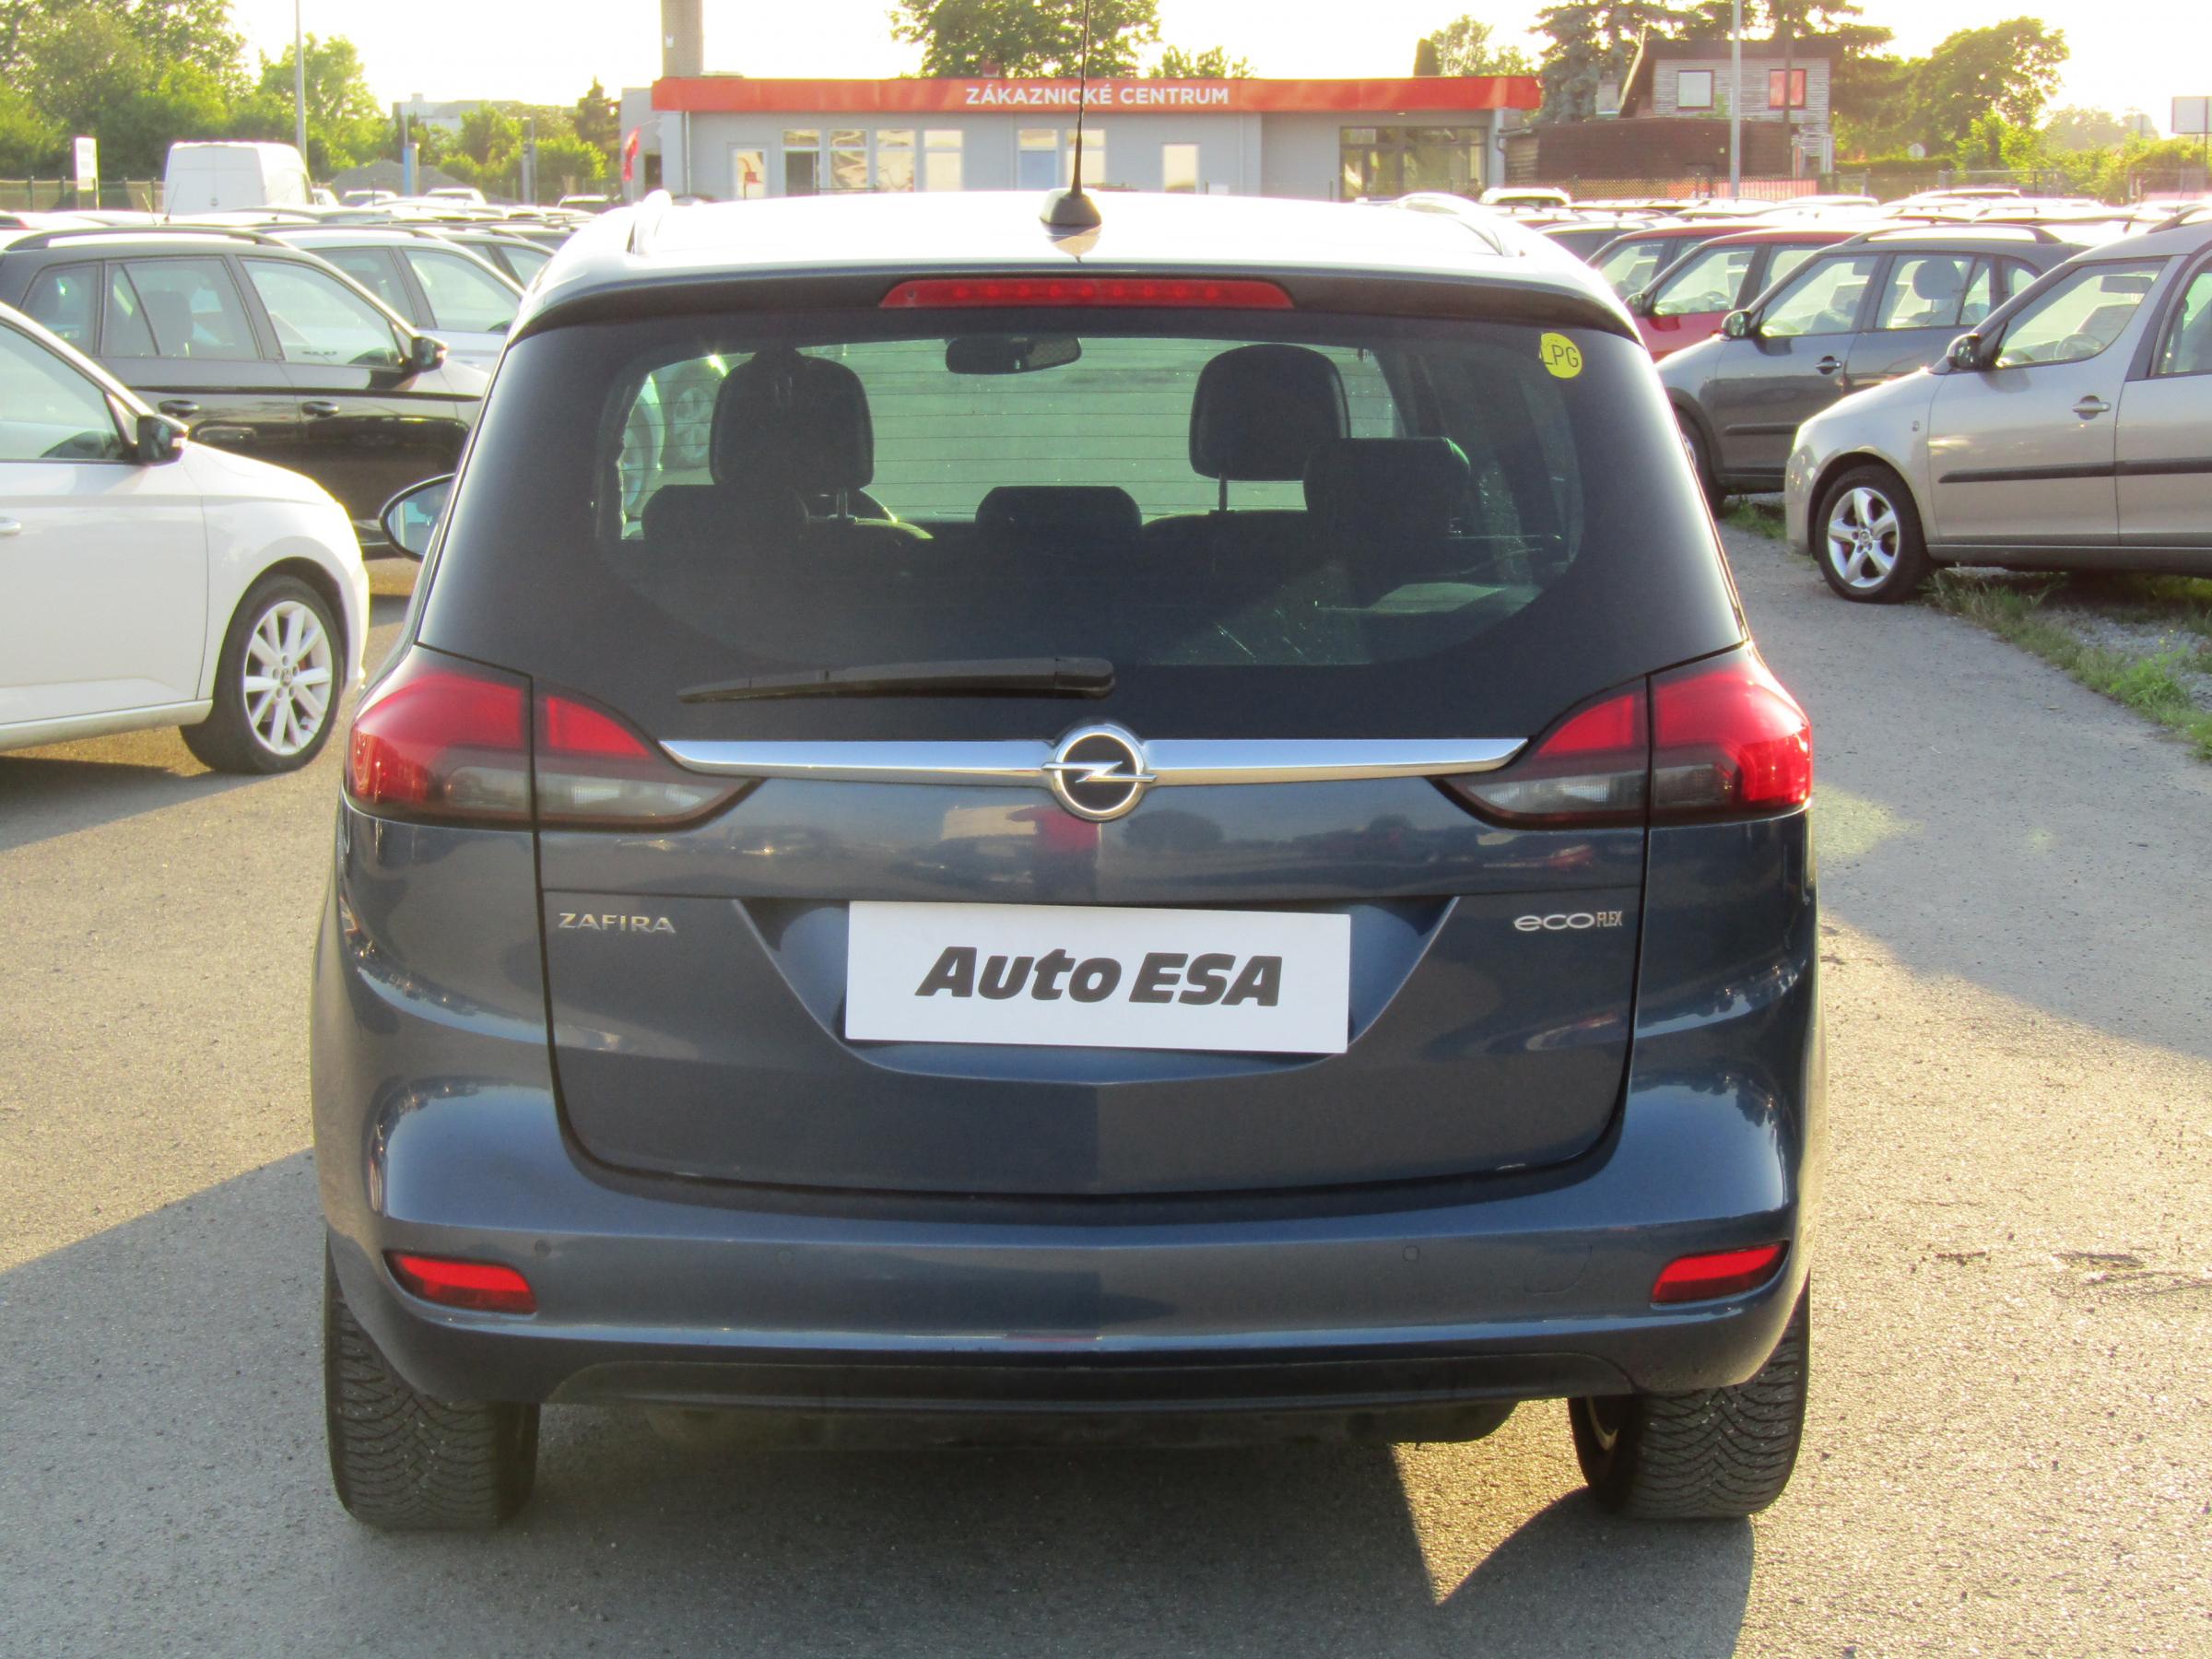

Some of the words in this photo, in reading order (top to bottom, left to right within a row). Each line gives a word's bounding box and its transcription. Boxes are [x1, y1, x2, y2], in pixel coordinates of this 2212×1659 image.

[966, 83, 1112, 105] ZÁKAZNICKÉ
[1120, 87, 1229, 105] CENTRUM
[558, 912, 677, 934] ZAFIRA
[915, 946, 1123, 1003] Auto
[1129, 951, 1283, 1007] ESA
